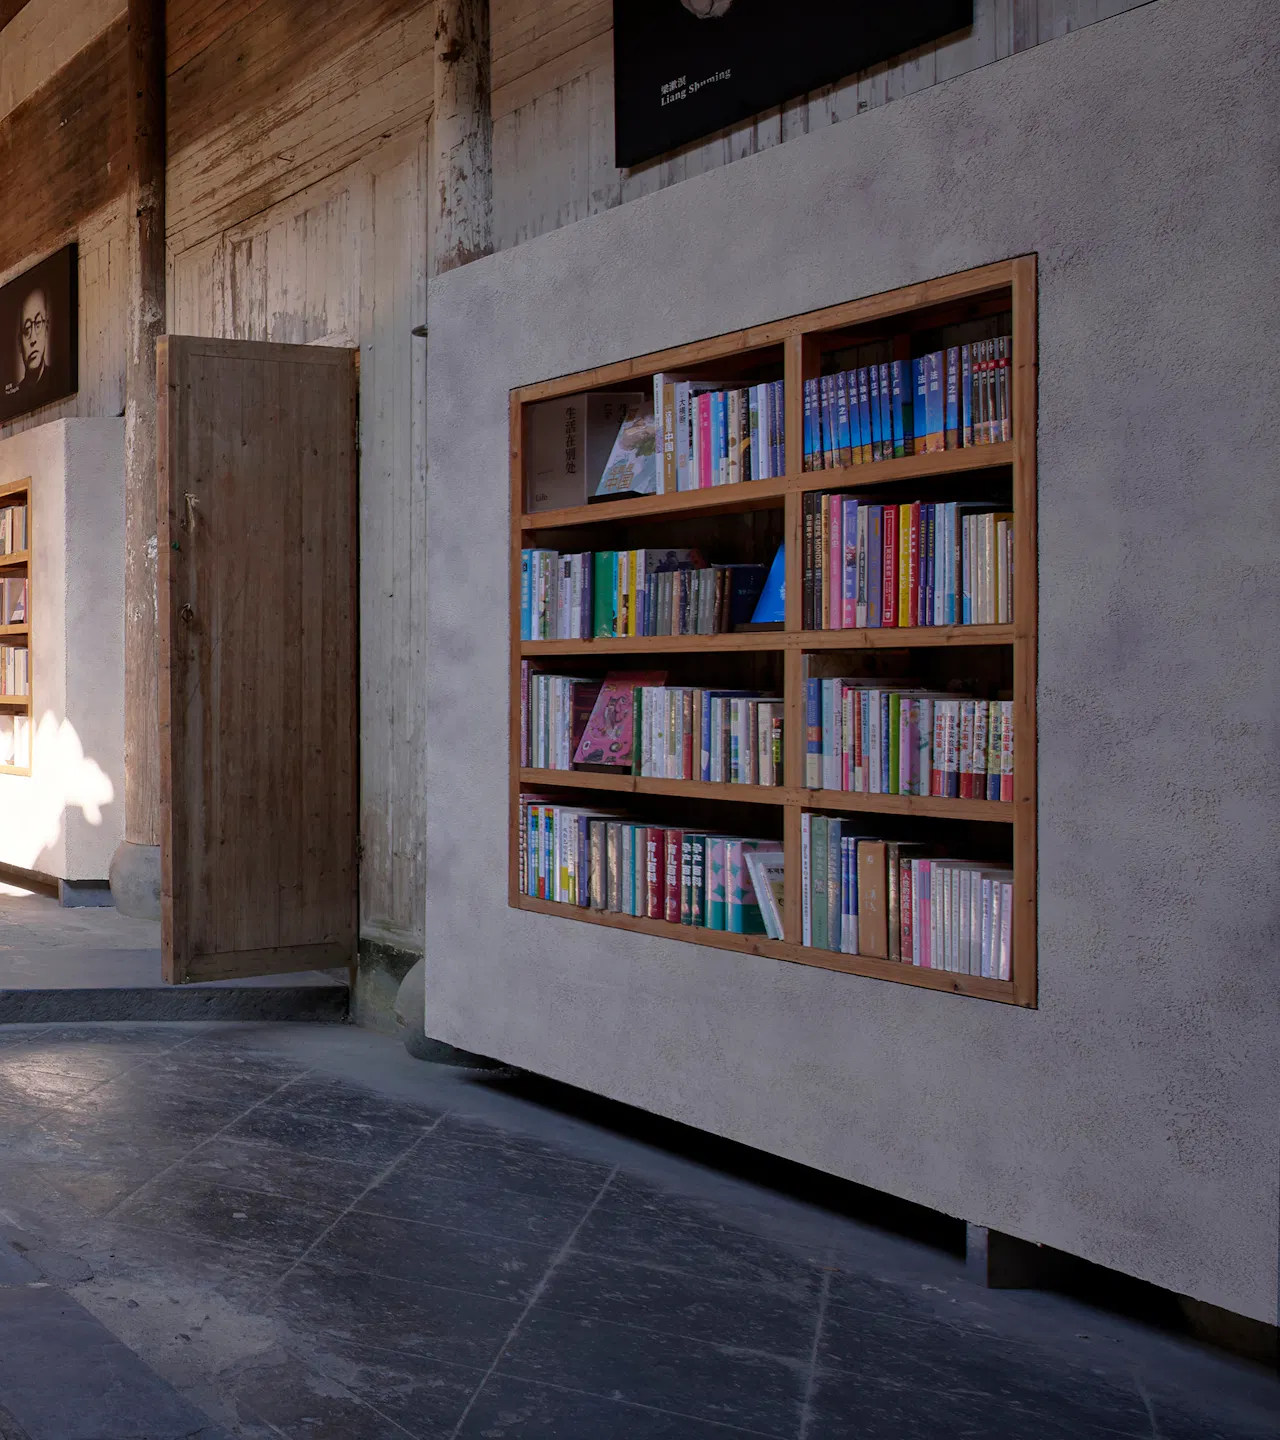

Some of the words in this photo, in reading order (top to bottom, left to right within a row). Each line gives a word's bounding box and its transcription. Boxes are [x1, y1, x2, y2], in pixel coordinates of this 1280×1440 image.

[661, 89, 687, 106] Liang
[918, 375, 926, 395] 法国
[930, 370, 938, 392] 法国
[565, 405, 577, 475] 生活在别处
[535, 493, 548, 503] Life
[647, 841, 657, 883] 育儿百科
[667, 844, 677, 886] 育儿百科
